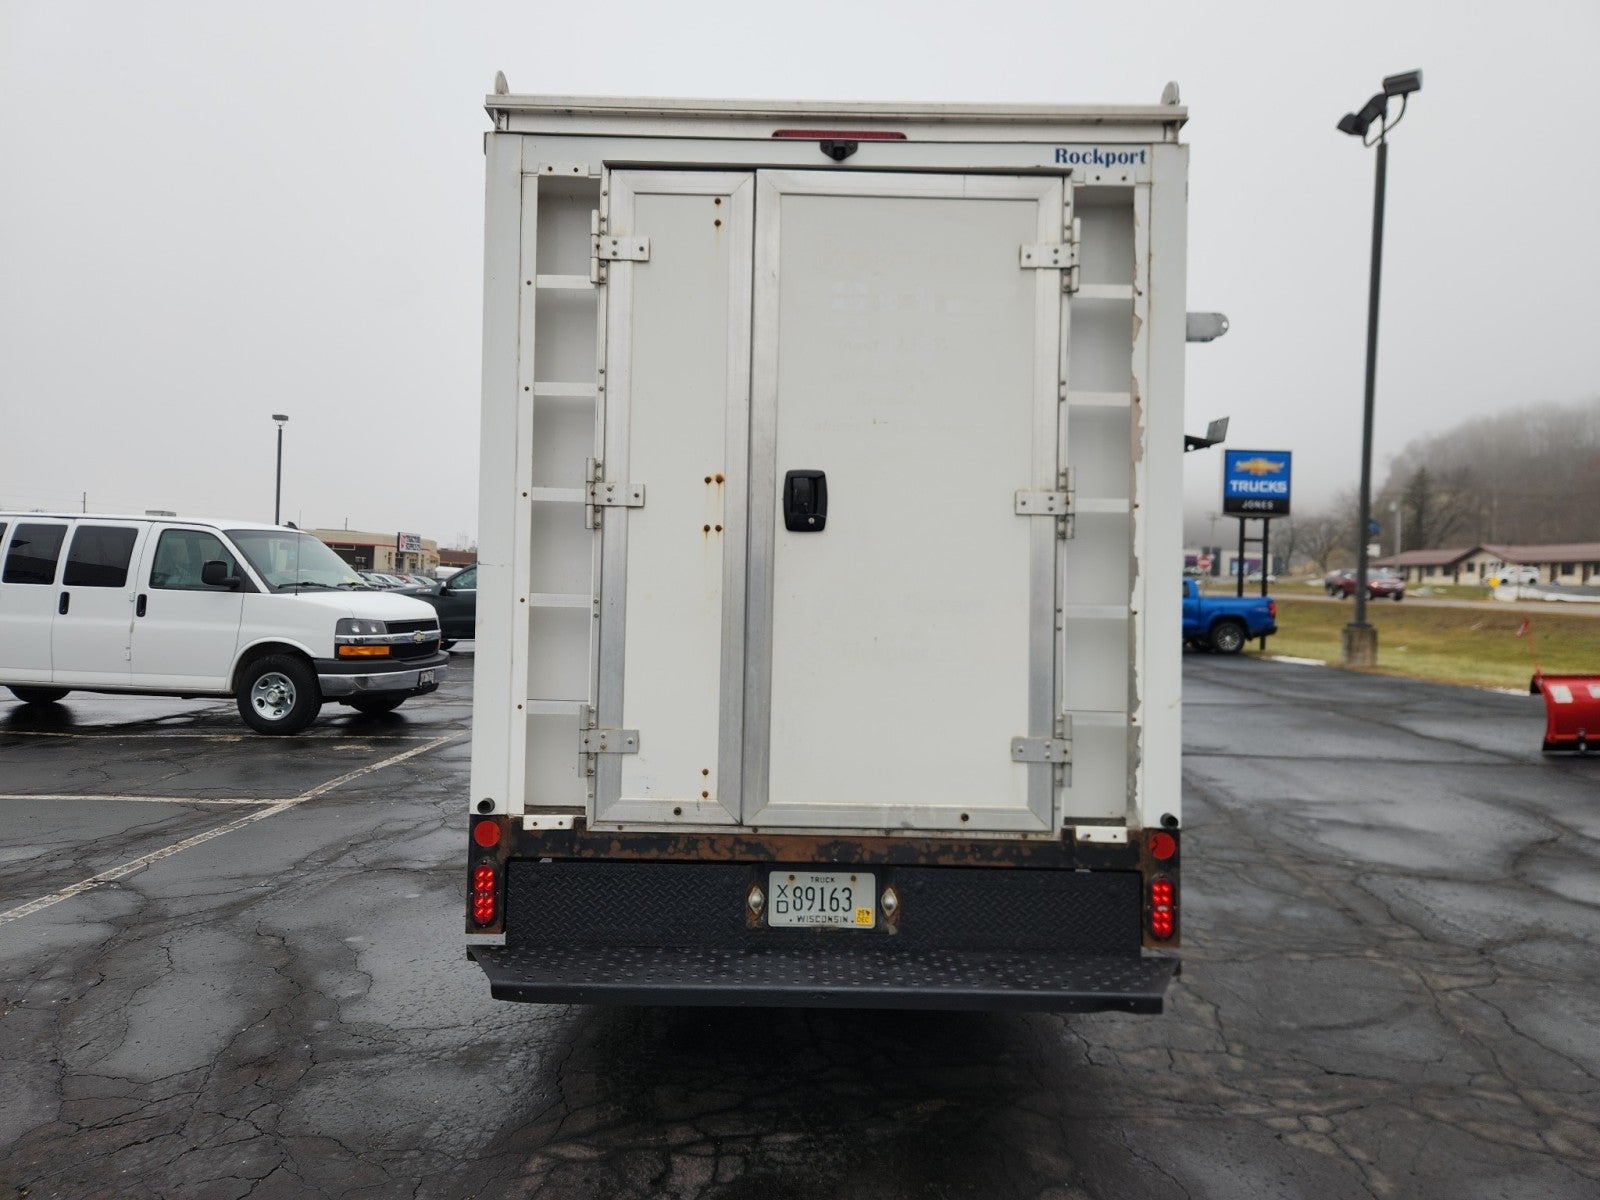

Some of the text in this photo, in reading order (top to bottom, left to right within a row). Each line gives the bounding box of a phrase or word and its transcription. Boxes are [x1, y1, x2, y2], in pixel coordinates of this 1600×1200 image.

[1055, 148, 1146, 168] Rockport
[1230, 480, 1287, 493] TRUCKS
[1241, 500, 1273, 510] JONES
[793, 886, 852, 912] 89163
[797, 915, 848, 923] WISCONSIN
